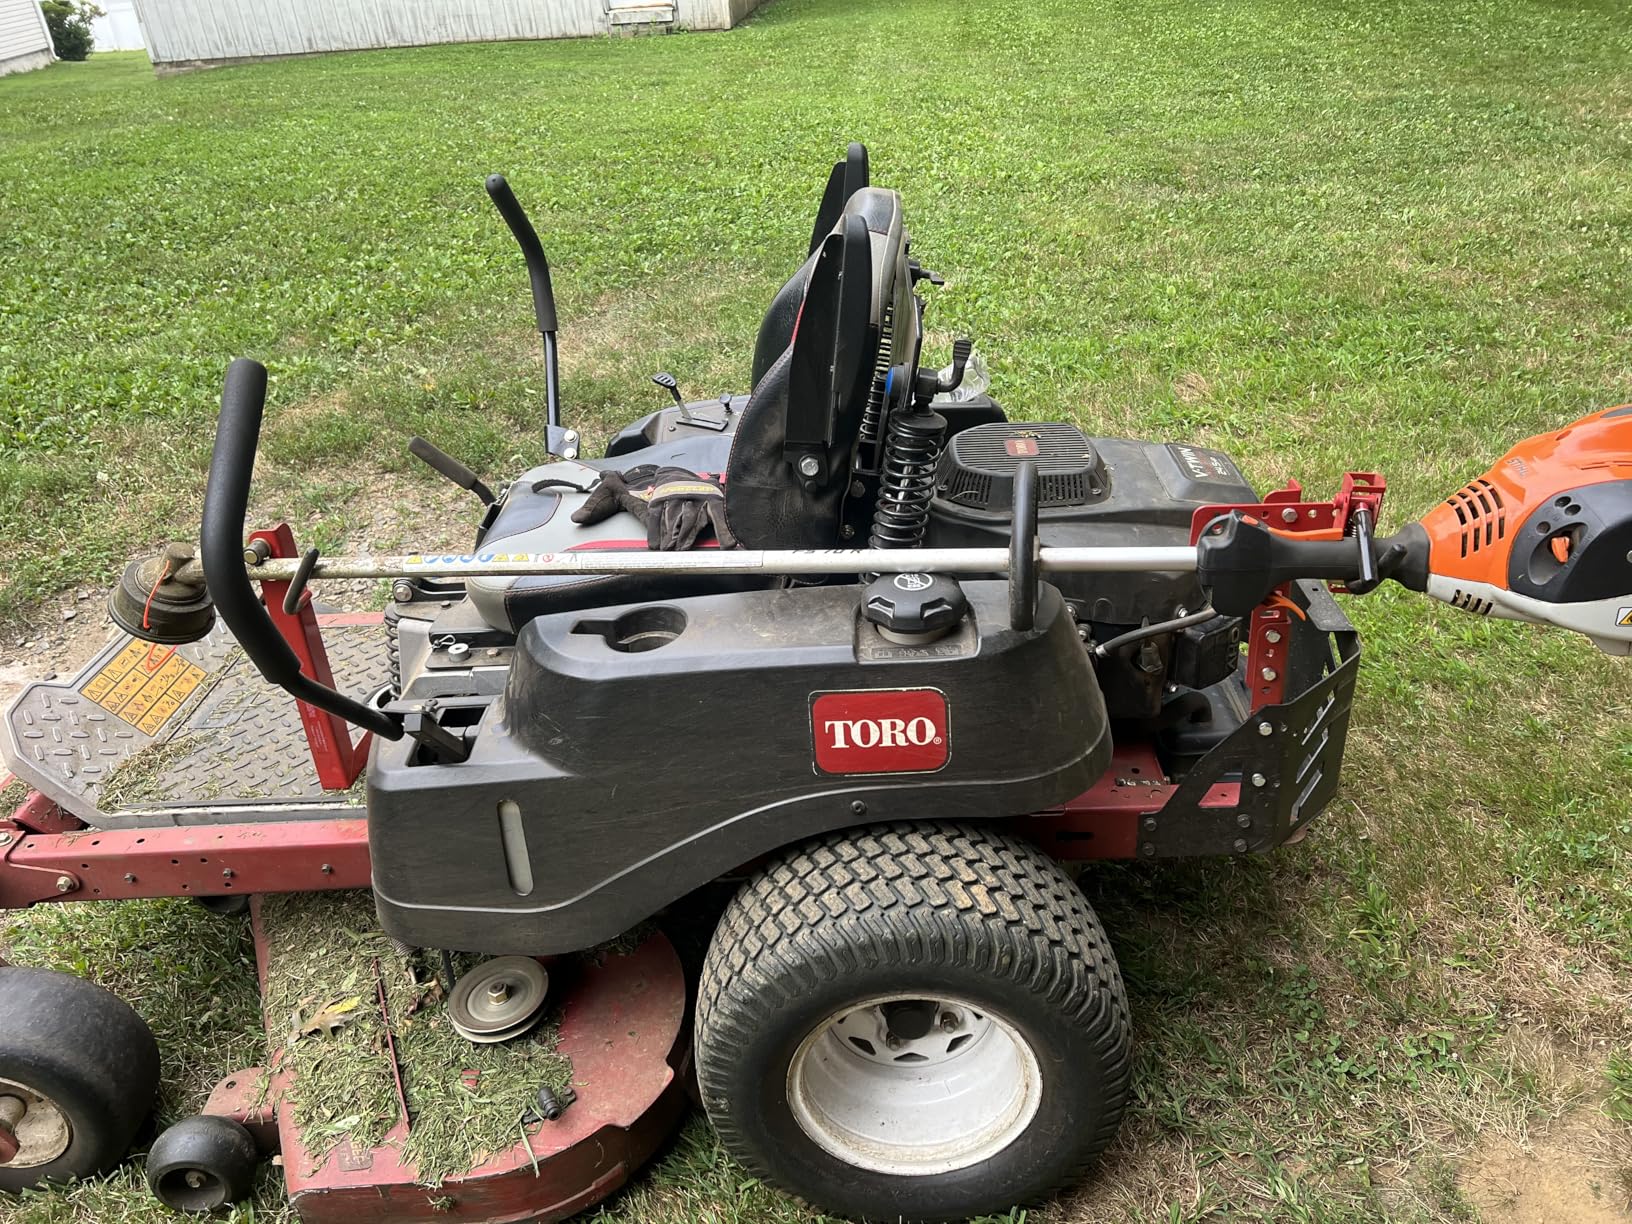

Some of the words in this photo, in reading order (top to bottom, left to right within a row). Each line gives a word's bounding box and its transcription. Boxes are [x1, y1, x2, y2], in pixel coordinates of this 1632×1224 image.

[1178, 447, 1208, 477] V-TWIN
[1506, 457, 1528, 478] STIHL
[825, 716, 937, 748] TORO
